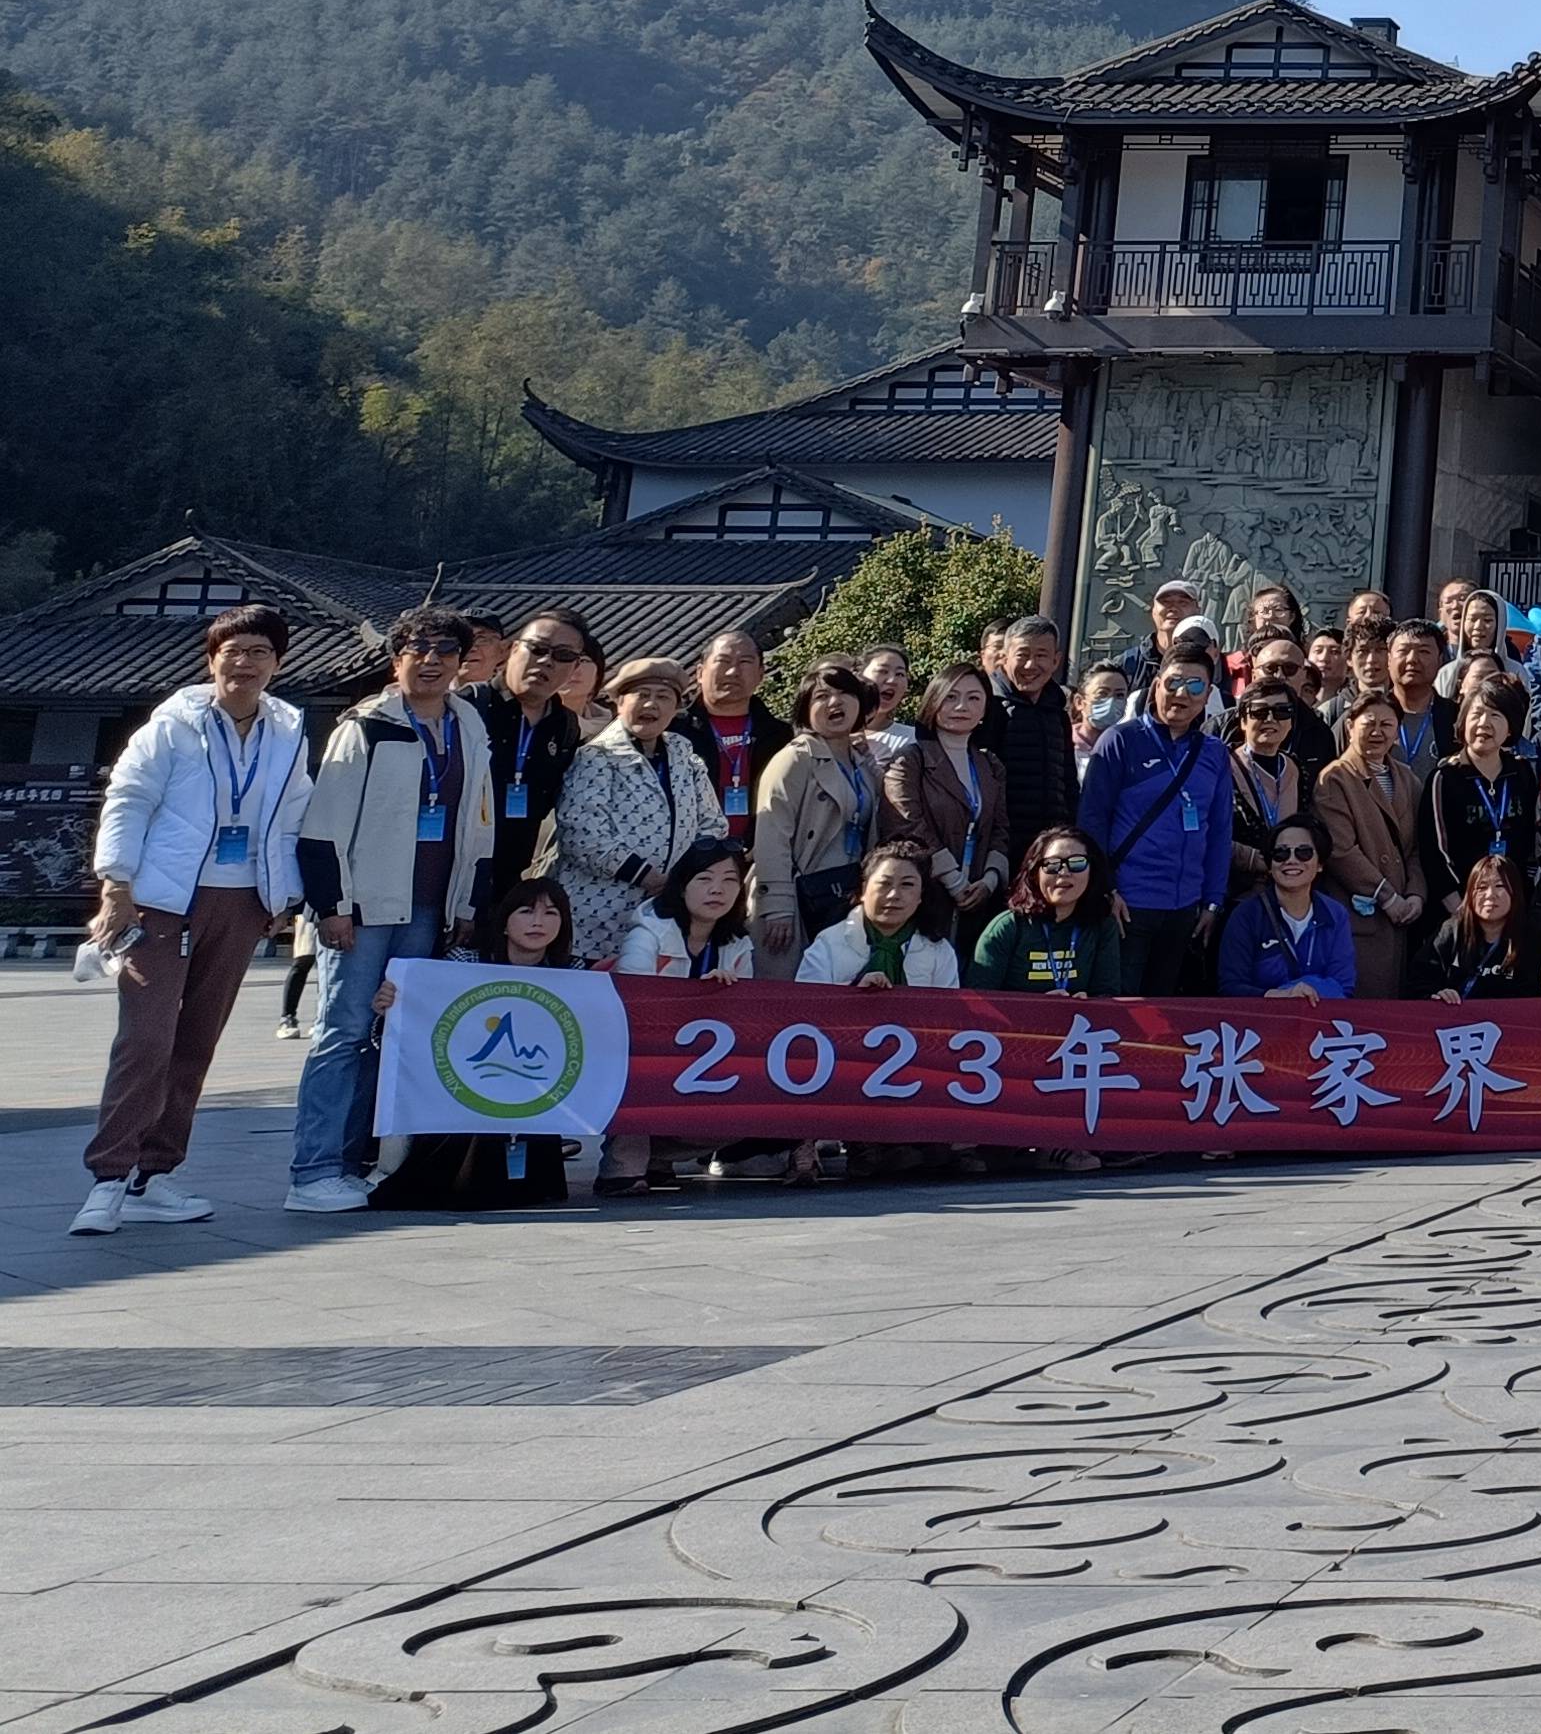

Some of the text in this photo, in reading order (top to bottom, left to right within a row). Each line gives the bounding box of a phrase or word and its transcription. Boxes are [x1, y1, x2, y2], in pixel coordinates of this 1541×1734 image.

[448, 983, 523, 1023] International
[525, 984, 565, 1015] Travel
[558, 1009, 579, 1058] Service
